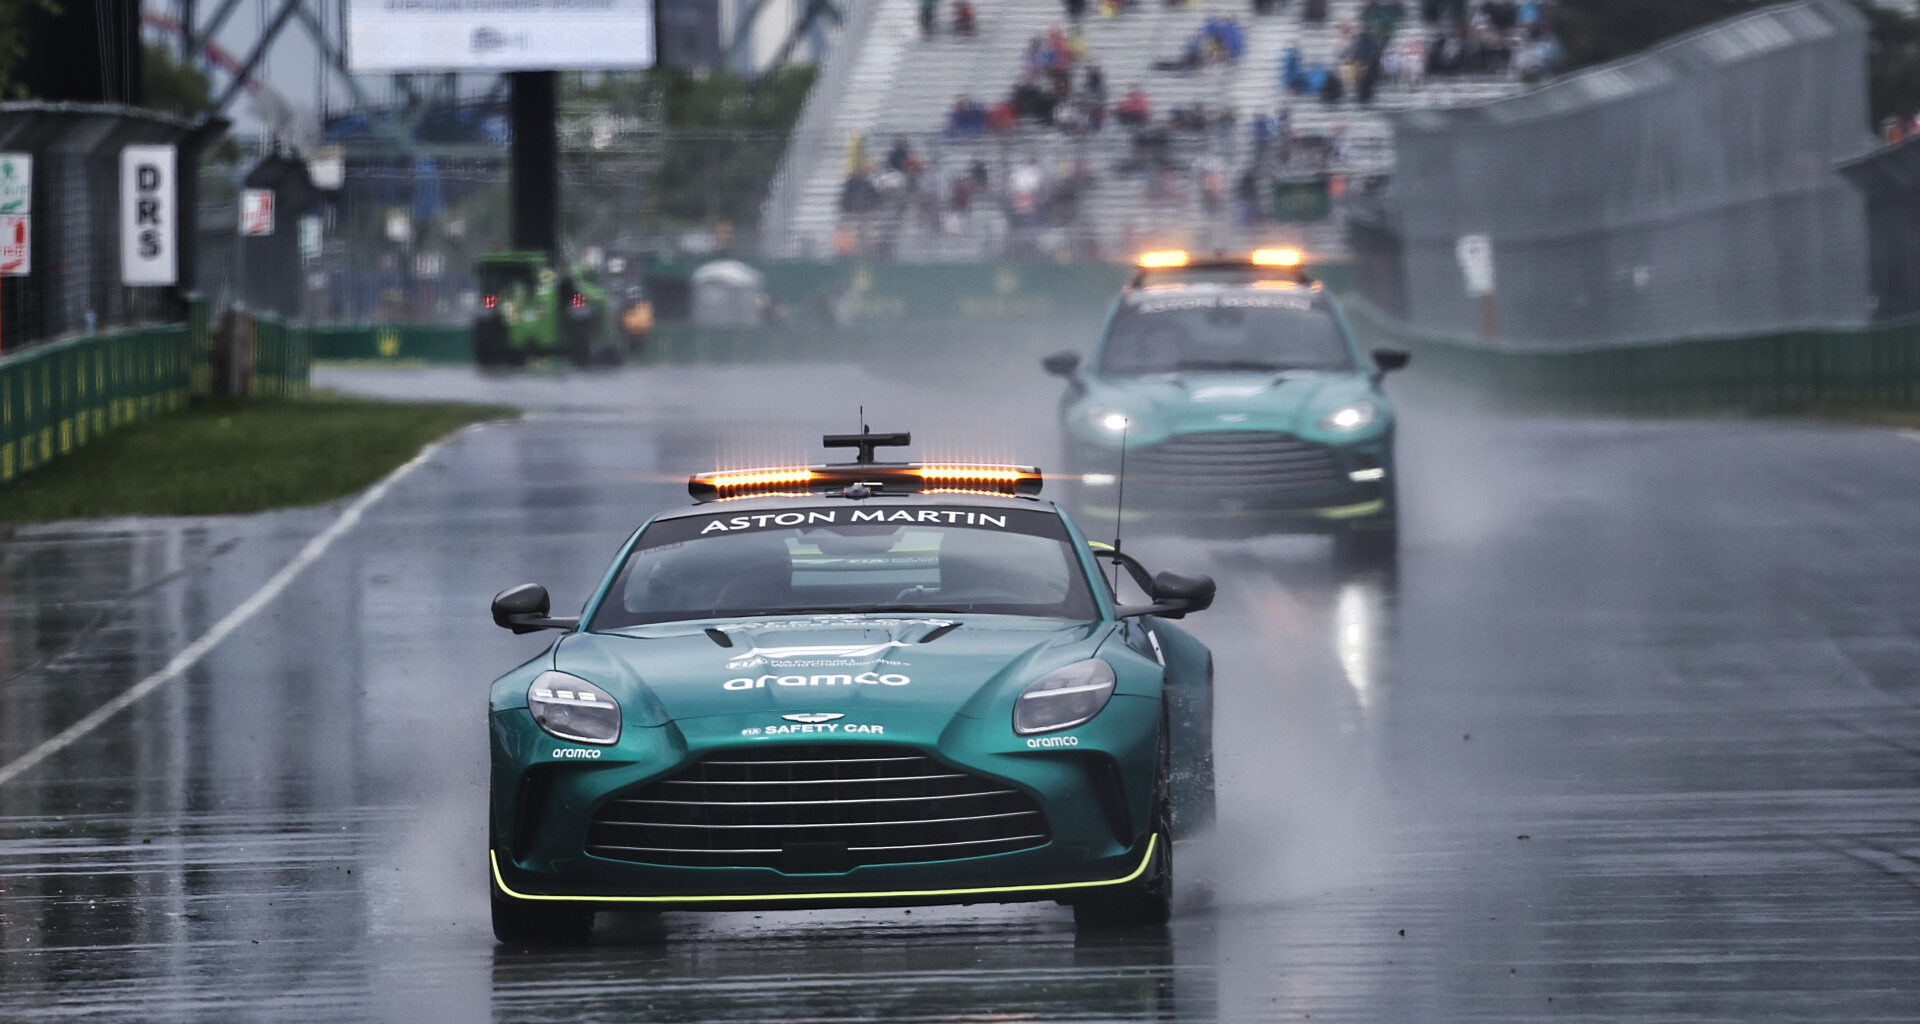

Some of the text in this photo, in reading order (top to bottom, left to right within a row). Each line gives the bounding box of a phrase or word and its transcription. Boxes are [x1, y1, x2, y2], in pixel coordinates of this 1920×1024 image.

[136, 163, 161, 261] DRS
[701, 509, 1007, 535] ASTON MARTIN
[723, 671, 911, 691] aramco
[765, 723, 839, 735] SAFETY
[844, 723, 884, 735] CAR
[1027, 736, 1078, 748] aramco
[552, 748, 601, 758] aramco
